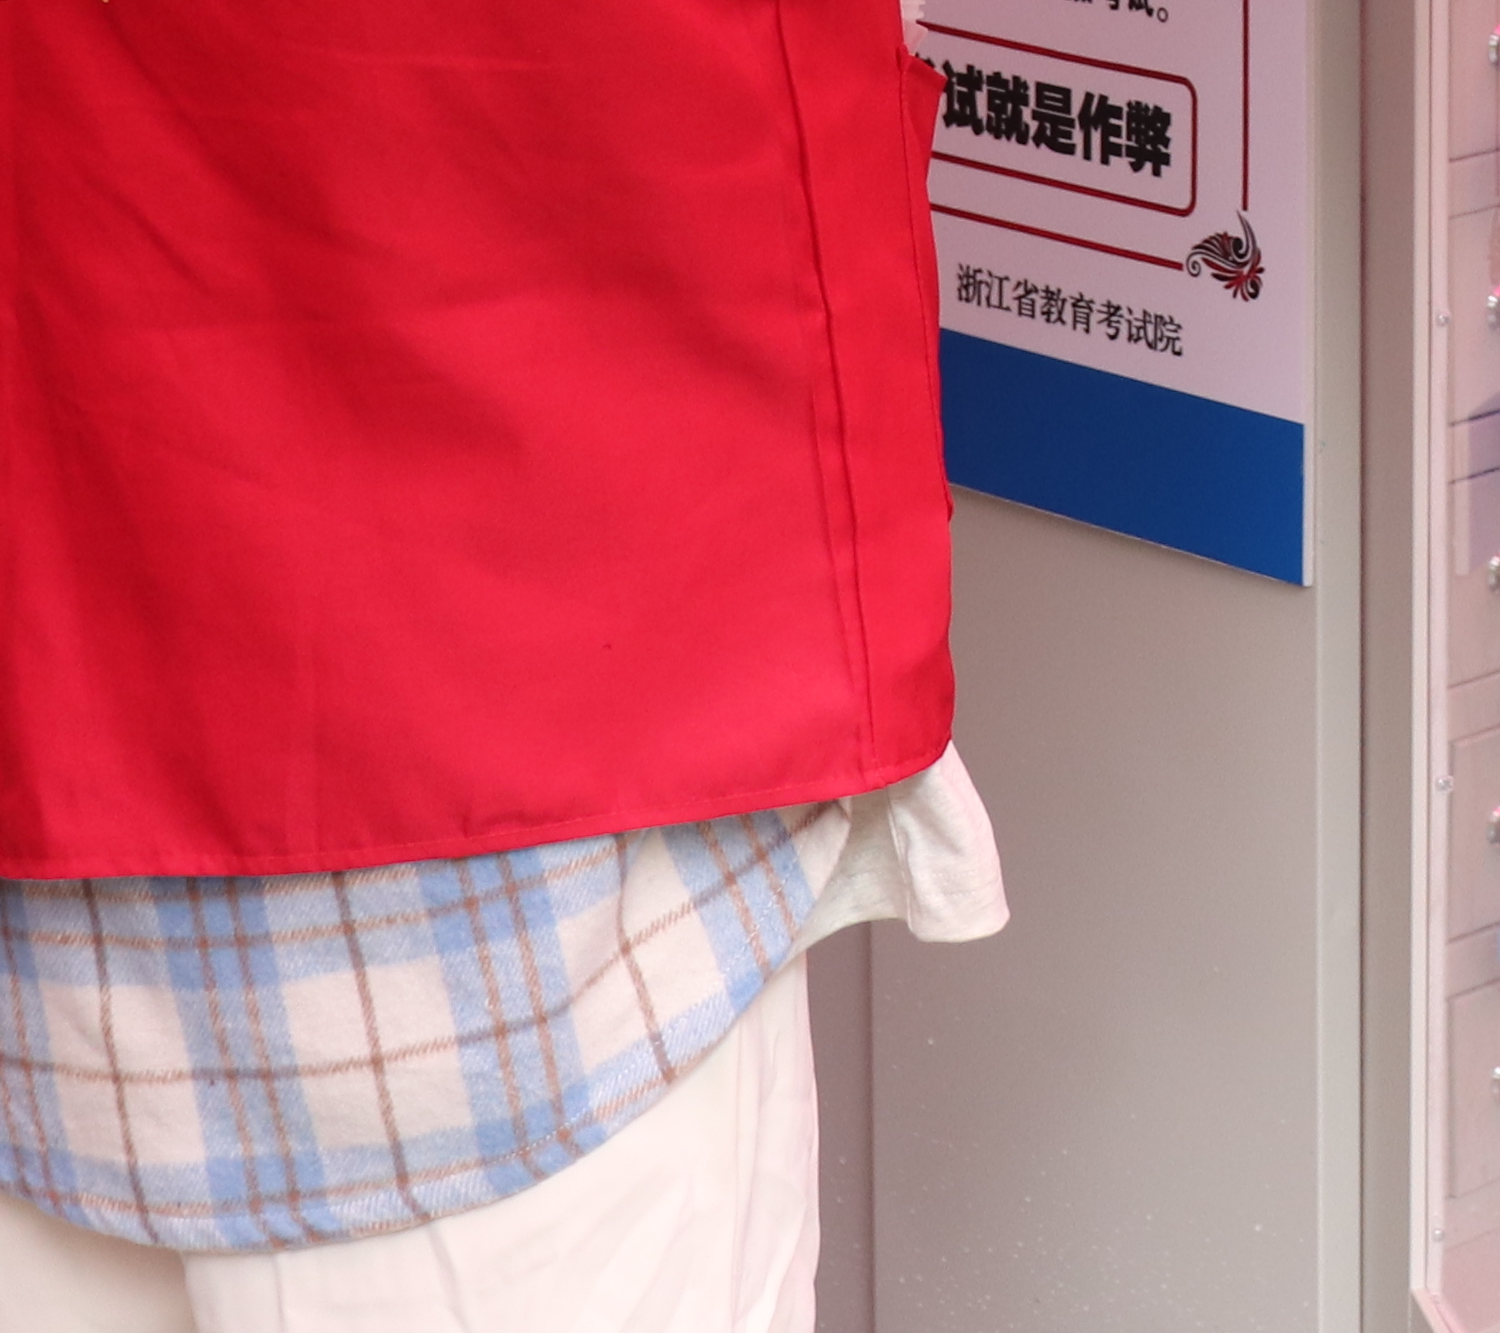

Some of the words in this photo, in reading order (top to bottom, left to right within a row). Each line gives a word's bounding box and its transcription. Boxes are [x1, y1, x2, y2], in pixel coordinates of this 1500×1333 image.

[916, 52, 1173, 178] 试就是作弊
[956, 262, 1183, 357] 浙江省教育考试院
